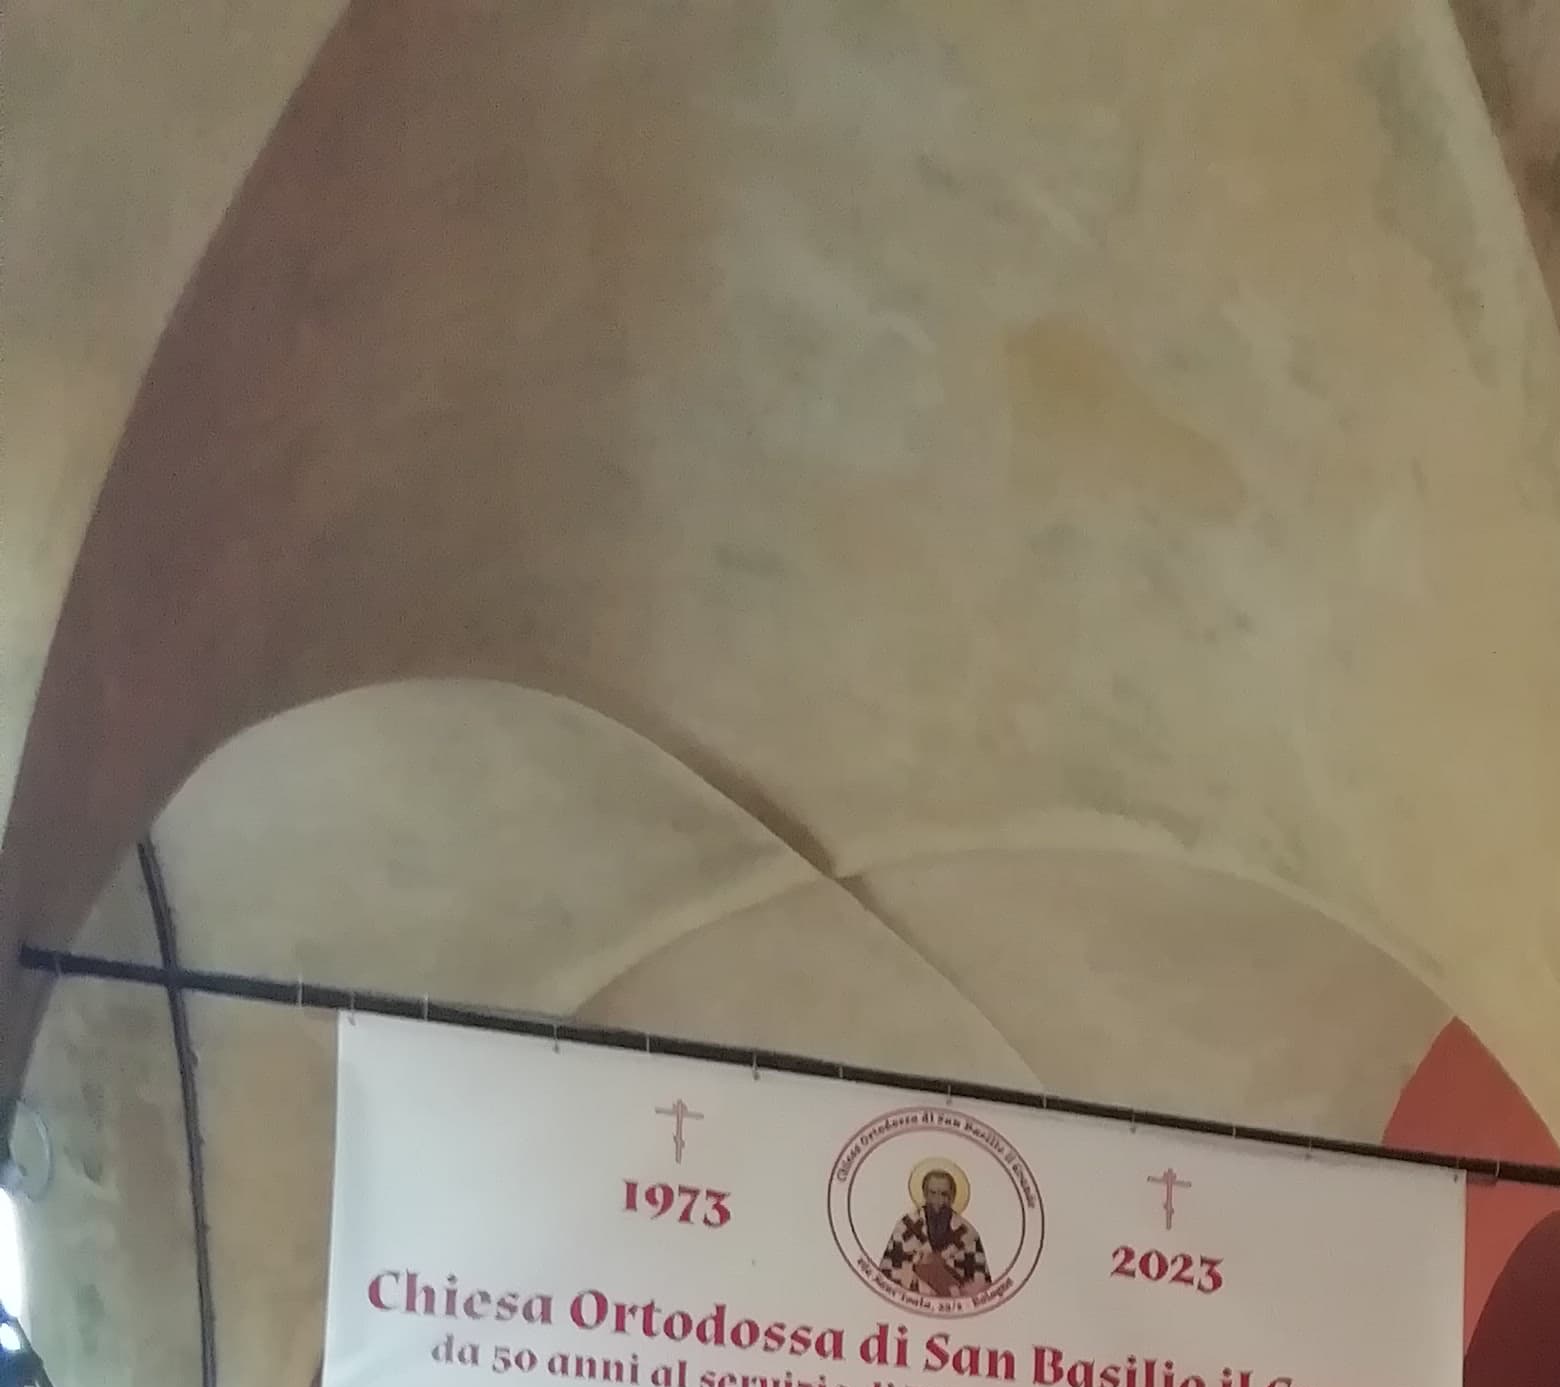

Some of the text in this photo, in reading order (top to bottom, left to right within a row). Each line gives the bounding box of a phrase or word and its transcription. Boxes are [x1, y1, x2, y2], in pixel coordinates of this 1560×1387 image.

[624, 1180, 731, 1228] 1973
[1111, 1246, 1223, 1294] 2023
[368, 1269, 552, 1325] Chiesa
[570, 1289, 845, 1360] Ortodossa
[860, 1322, 910, 1368] di
[923, 1333, 1015, 1382] San
[431, 1334, 479, 1366] da
[492, 1346, 538, 1373] 50
[548, 1353, 639, 1385] anni
